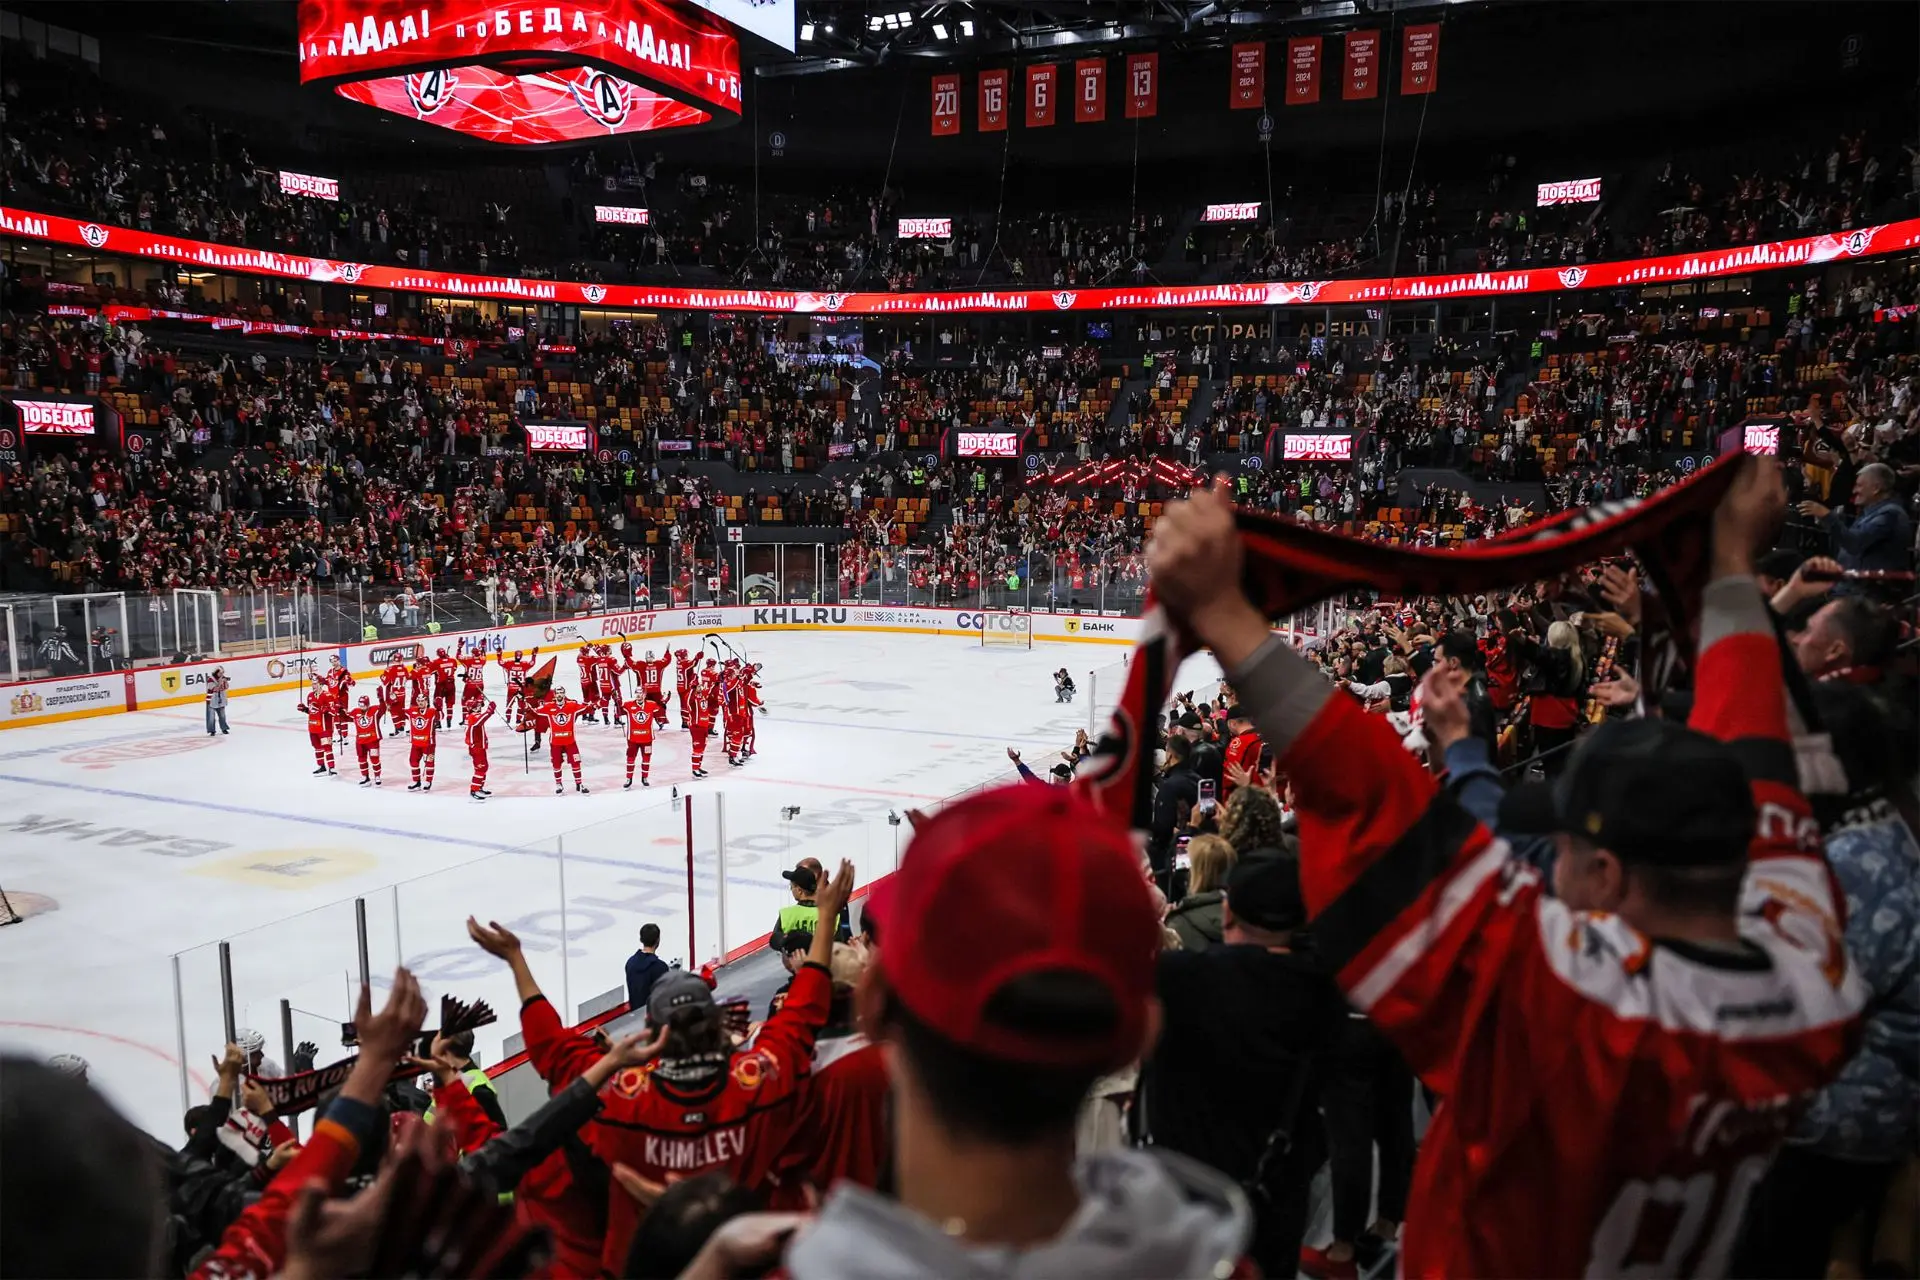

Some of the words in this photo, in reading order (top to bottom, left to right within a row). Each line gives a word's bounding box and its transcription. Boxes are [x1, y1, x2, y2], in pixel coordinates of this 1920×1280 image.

[1133, 70, 1151, 97] 13
[1239, 77, 1255, 87] 2024
[1295, 72, 1311, 82] 2024
[1035, 83, 1047, 108] 6
[1085, 77, 1097, 101] 8
[935, 91, 957, 116] 20
[984, 88, 1002, 113] 16
[283, 175, 337, 196] ПОБЕДА!
[1541, 183, 1598, 200] ПОБЕДА!
[597, 208, 646, 224] ПОБЕДА!
[1209, 206, 1258, 220] ПОБЕДА!
[901, 222, 948, 234] ПОБЕДА!
[1299, 320, 1370, 338] АРЕНА
[961, 437, 1014, 452] ПОБЕДА!
[1287, 438, 1349, 454] ПОБЕДА!
[1746, 430, 1777, 448] ПОБЕ
[754, 608, 847, 624] KHL.RU
[601, 615, 657, 637] FONBET
[1083, 622, 1115, 632] БАНК
[373, 647, 413, 663] WININE
[185, 672, 208, 687] БА
[645, 669, 658, 684] 18
[645, 1126, 747, 1171] KHMELEV
